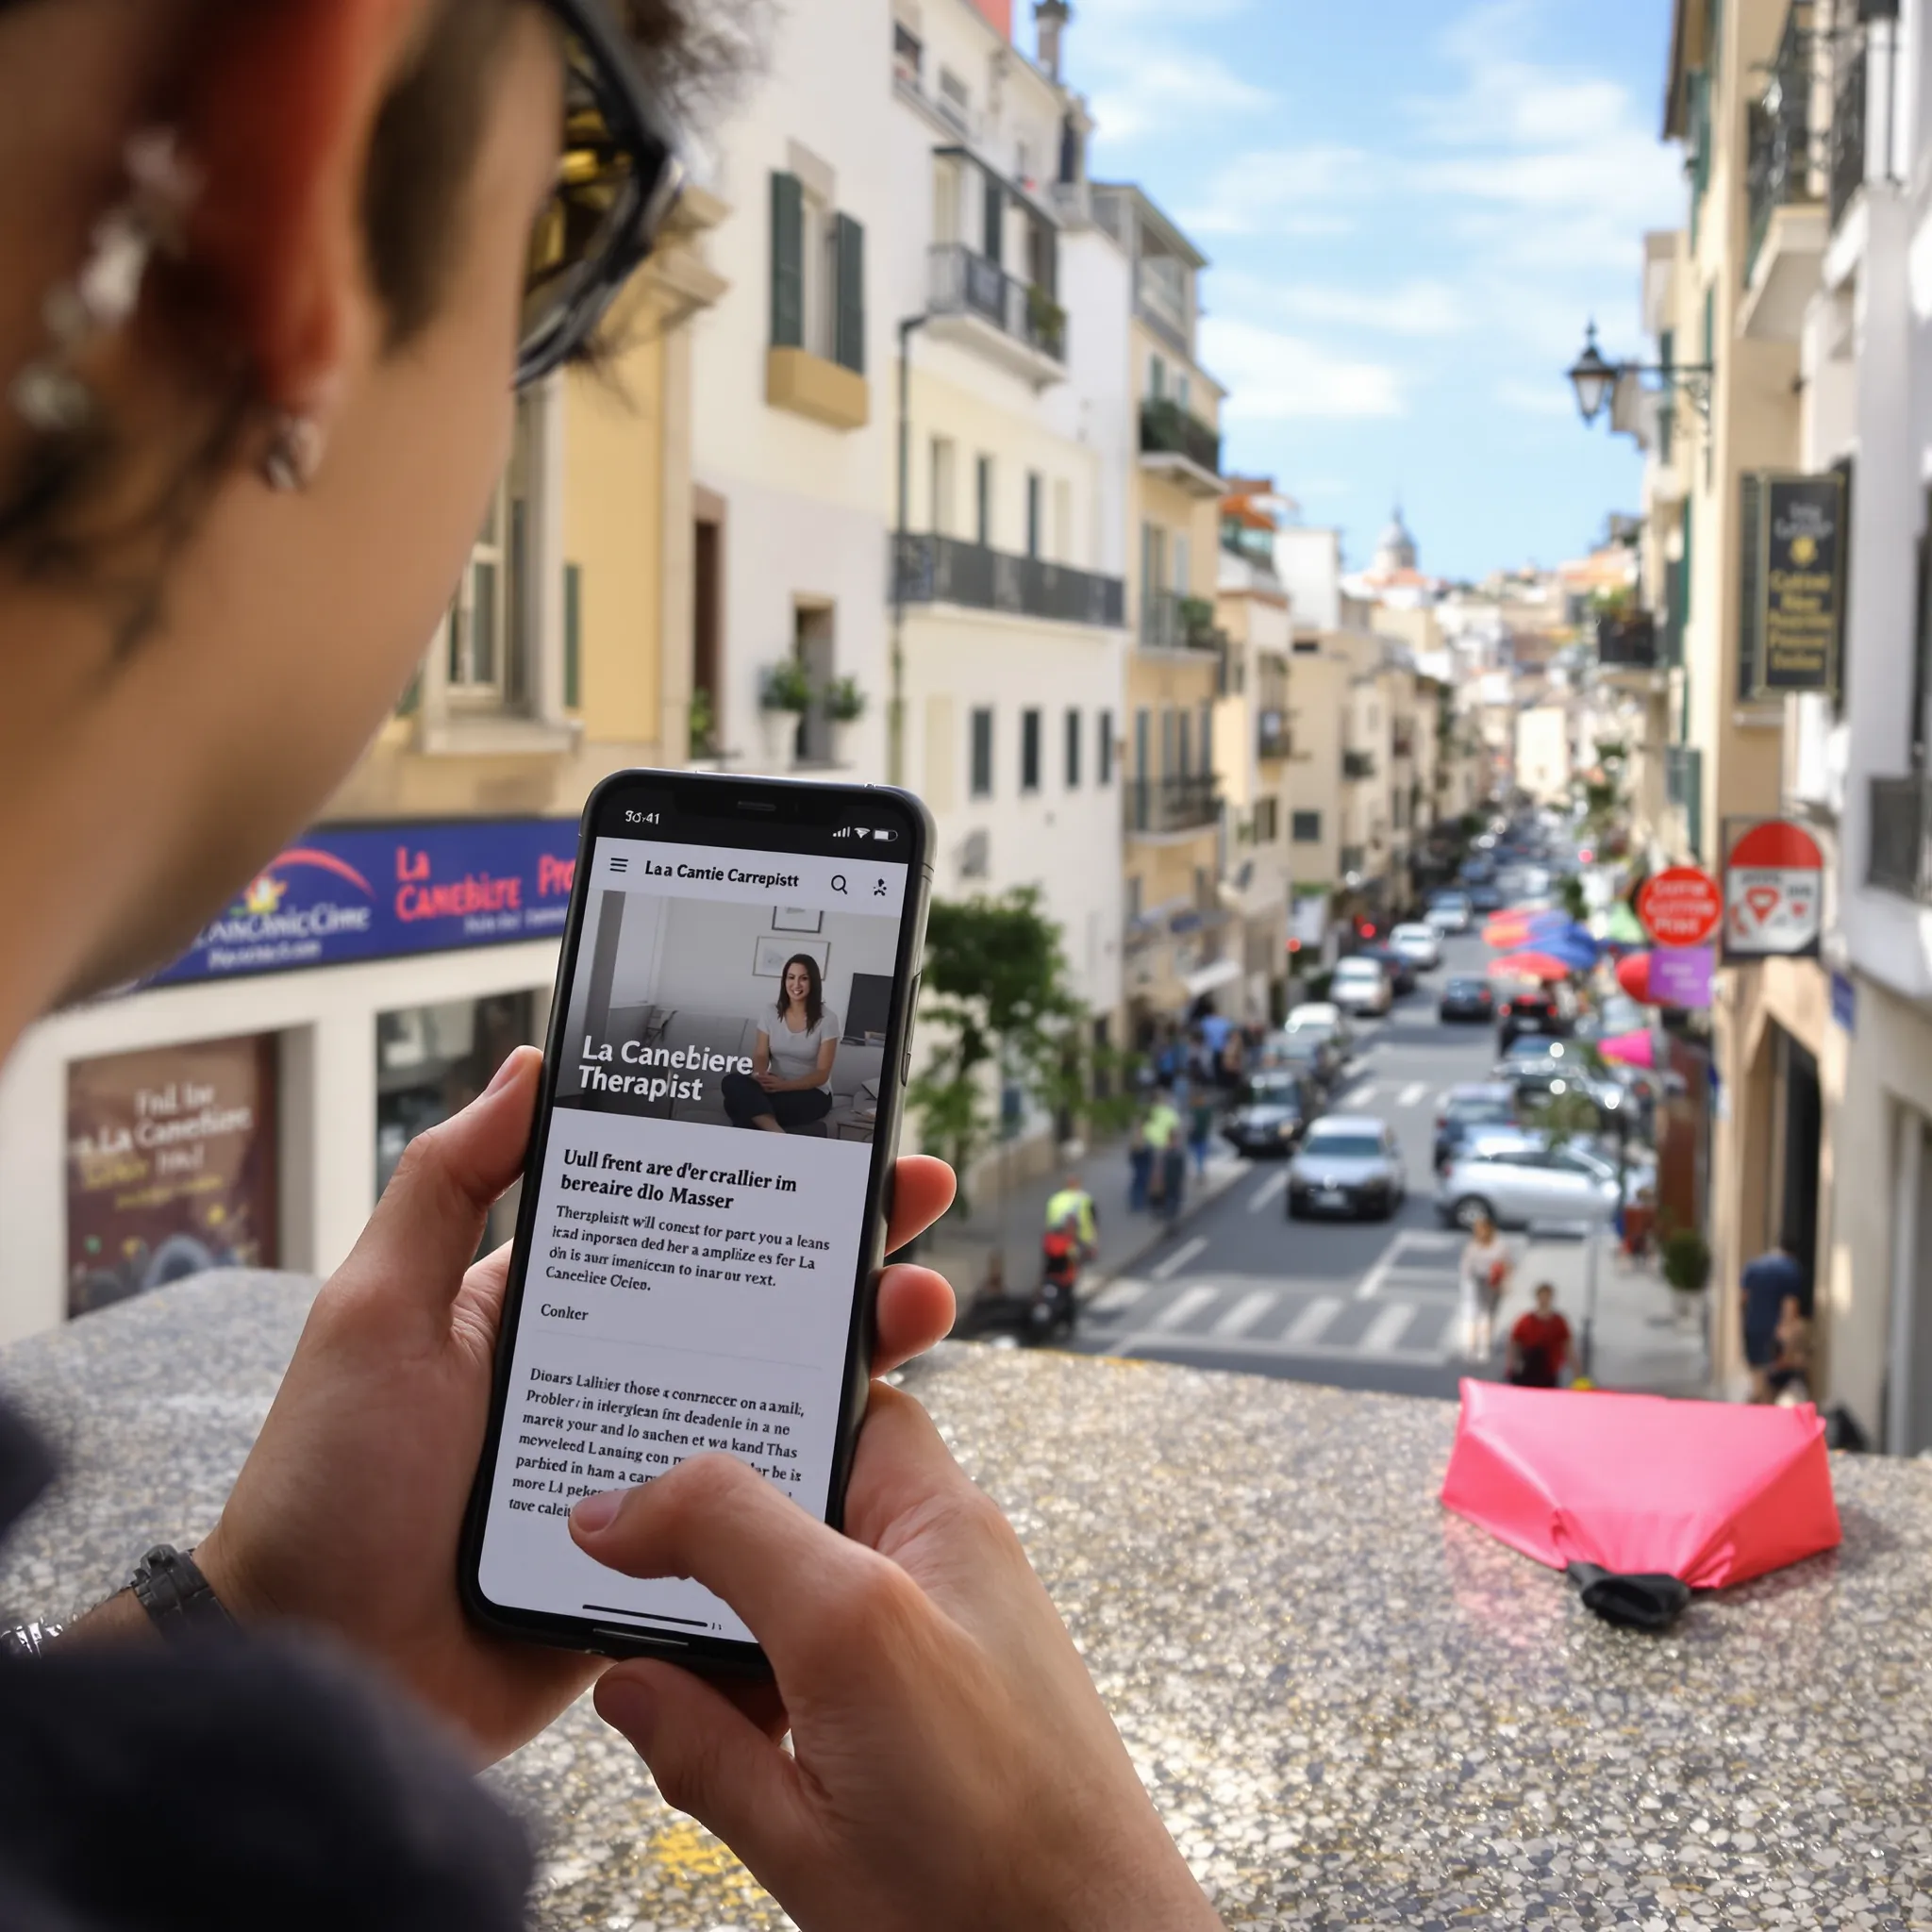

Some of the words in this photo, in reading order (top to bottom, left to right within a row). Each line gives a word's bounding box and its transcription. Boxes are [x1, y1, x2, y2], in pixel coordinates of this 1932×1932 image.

[582, 1035, 613, 1062] La
[621, 1040, 754, 1075] Canebiere
[578, 1065, 704, 1103] Therapist
[645, 1163, 674, 1177] are
[774, 1174, 797, 1192] im
[668, 1186, 735, 1209] Masser
[632, 1215, 656, 1230] will
[758, 1233, 783, 1245] you
[785, 1237, 793, 1246] a
[796, 1234, 830, 1251] leans
[641, 1237, 665, 1251] ded
[666, 1239, 690, 1255] her
[691, 1246, 699, 1257] a
[798, 1256, 815, 1270] La
[582, 1396, 594, 1410] in
[745, 1418, 758, 1432] in
[761, 1424, 770, 1433] a
[740, 1399, 757, 1410] on
[566, 1420, 598, 1432] your
[600, 1423, 625, 1437] and
[691, 1435, 705, 1447] et
[731, 1437, 764, 1455] kand
[511, 1478, 546, 1491] more
[570, 1460, 583, 1474] in
[587, 1463, 615, 1480] ham
[618, 1471, 625, 1481] a
[772, 1465, 787, 1480] be
